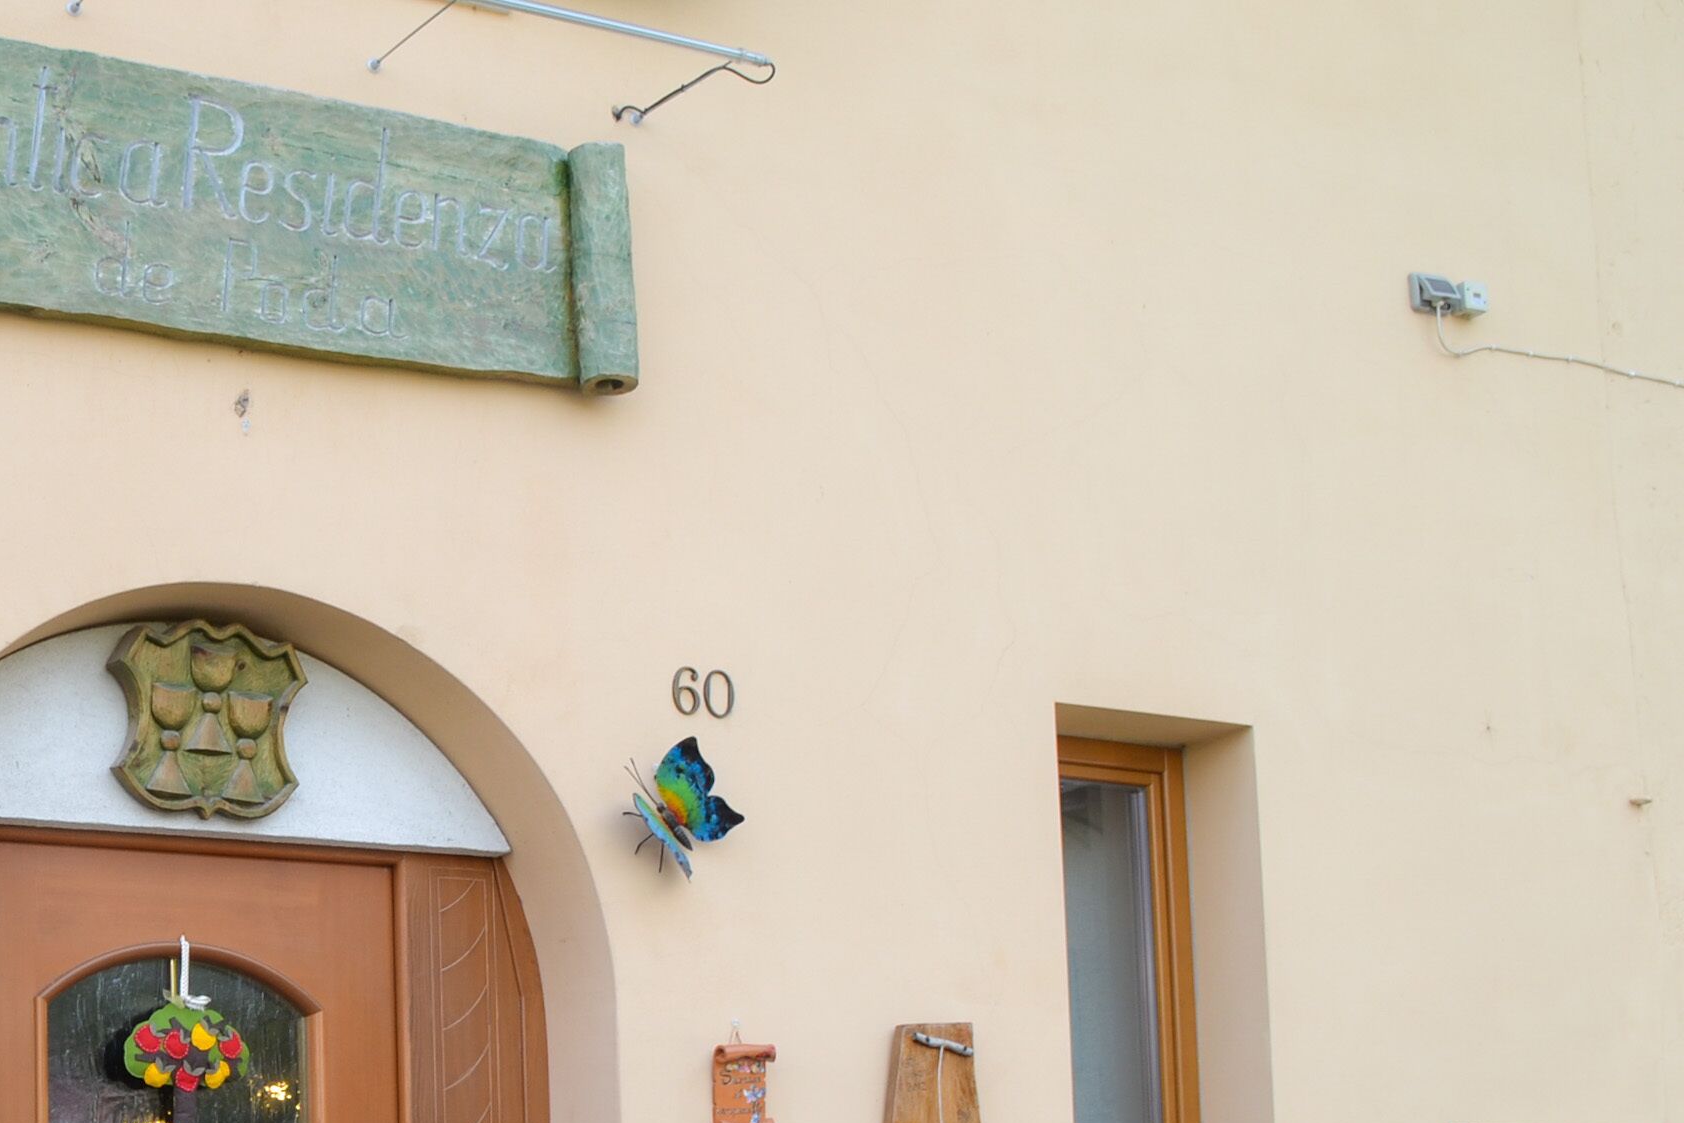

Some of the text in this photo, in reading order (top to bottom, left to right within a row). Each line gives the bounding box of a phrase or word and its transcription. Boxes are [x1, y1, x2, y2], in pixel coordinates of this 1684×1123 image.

[182, 93, 558, 273] Residenza
[93, 220, 409, 340] de Poda
[671, 665, 736, 720] 60
